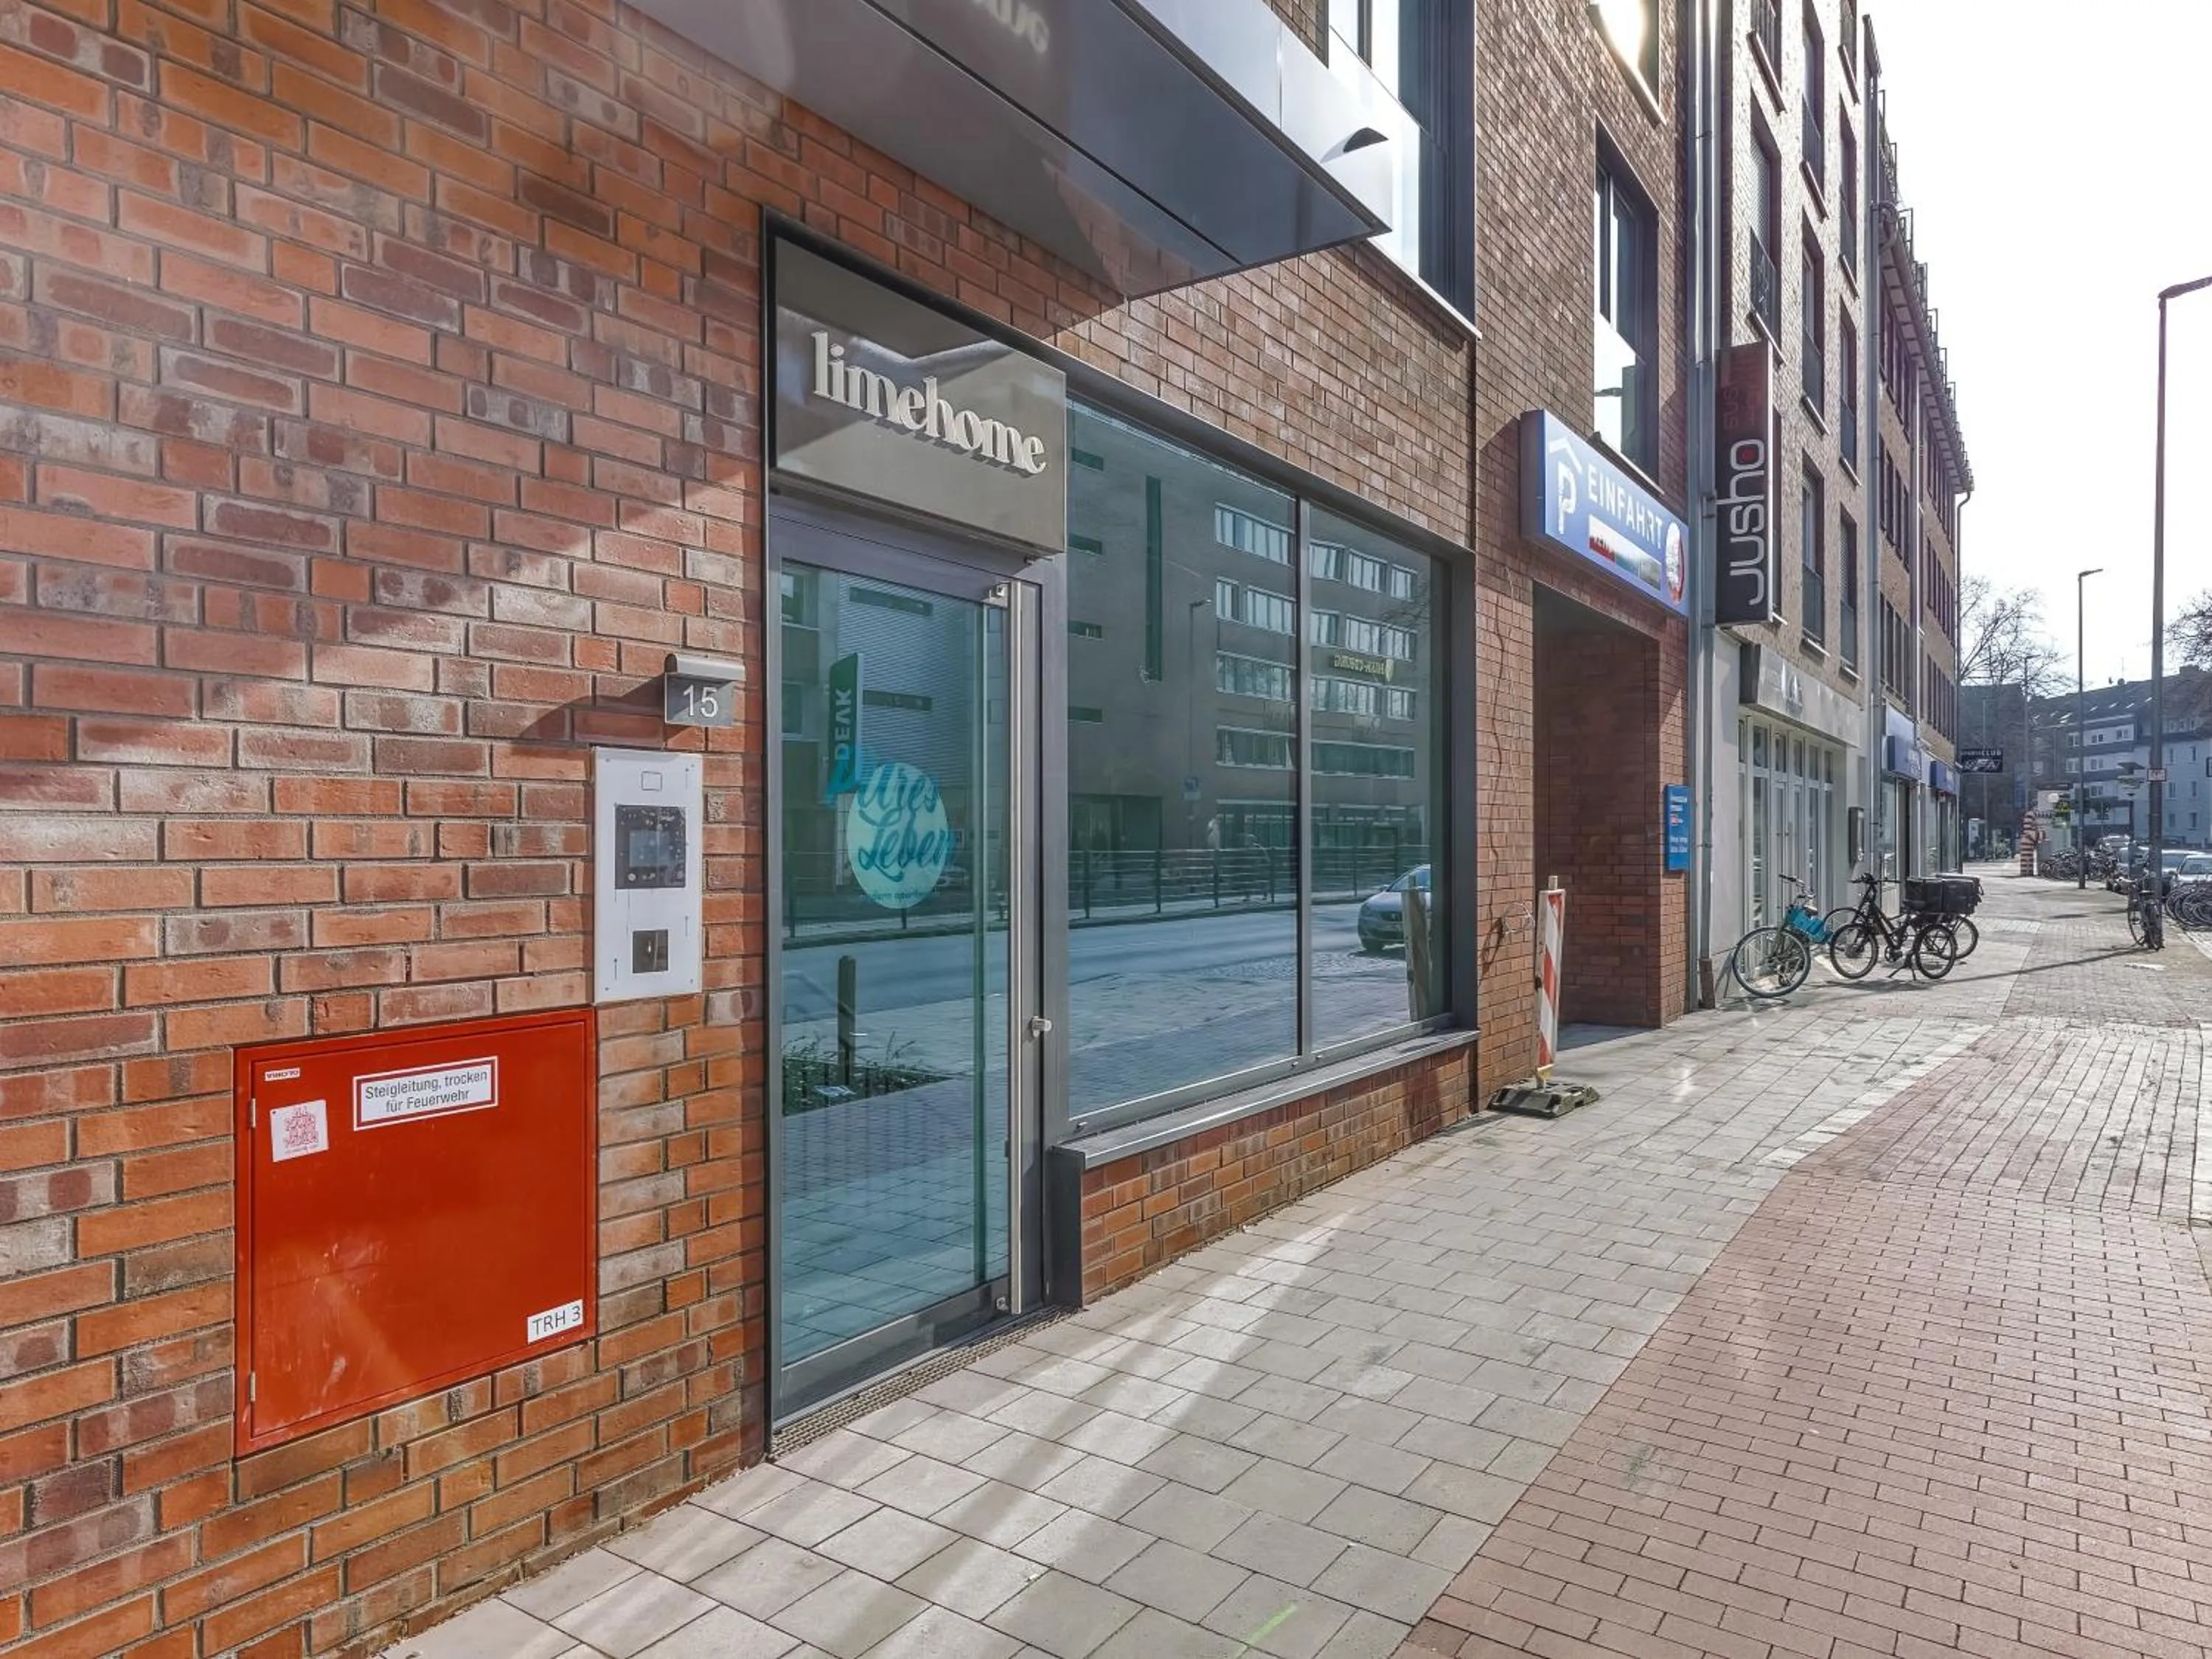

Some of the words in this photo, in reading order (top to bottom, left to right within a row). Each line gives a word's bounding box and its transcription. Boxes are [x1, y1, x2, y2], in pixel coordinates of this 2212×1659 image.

[811, 331, 1046, 474] limehome
[1587, 463, 1663, 549] EINFAHRT
[683, 685, 717, 718] 15
[365, 1079, 442, 1099] Steigleitung,
[445, 1071, 487, 1088] trocken
[386, 1099, 404, 1113] für
[407, 1088, 470, 1110] Feuerwehr
[532, 1310, 566, 1335] TRH
[571, 1306, 580, 1322] 3
